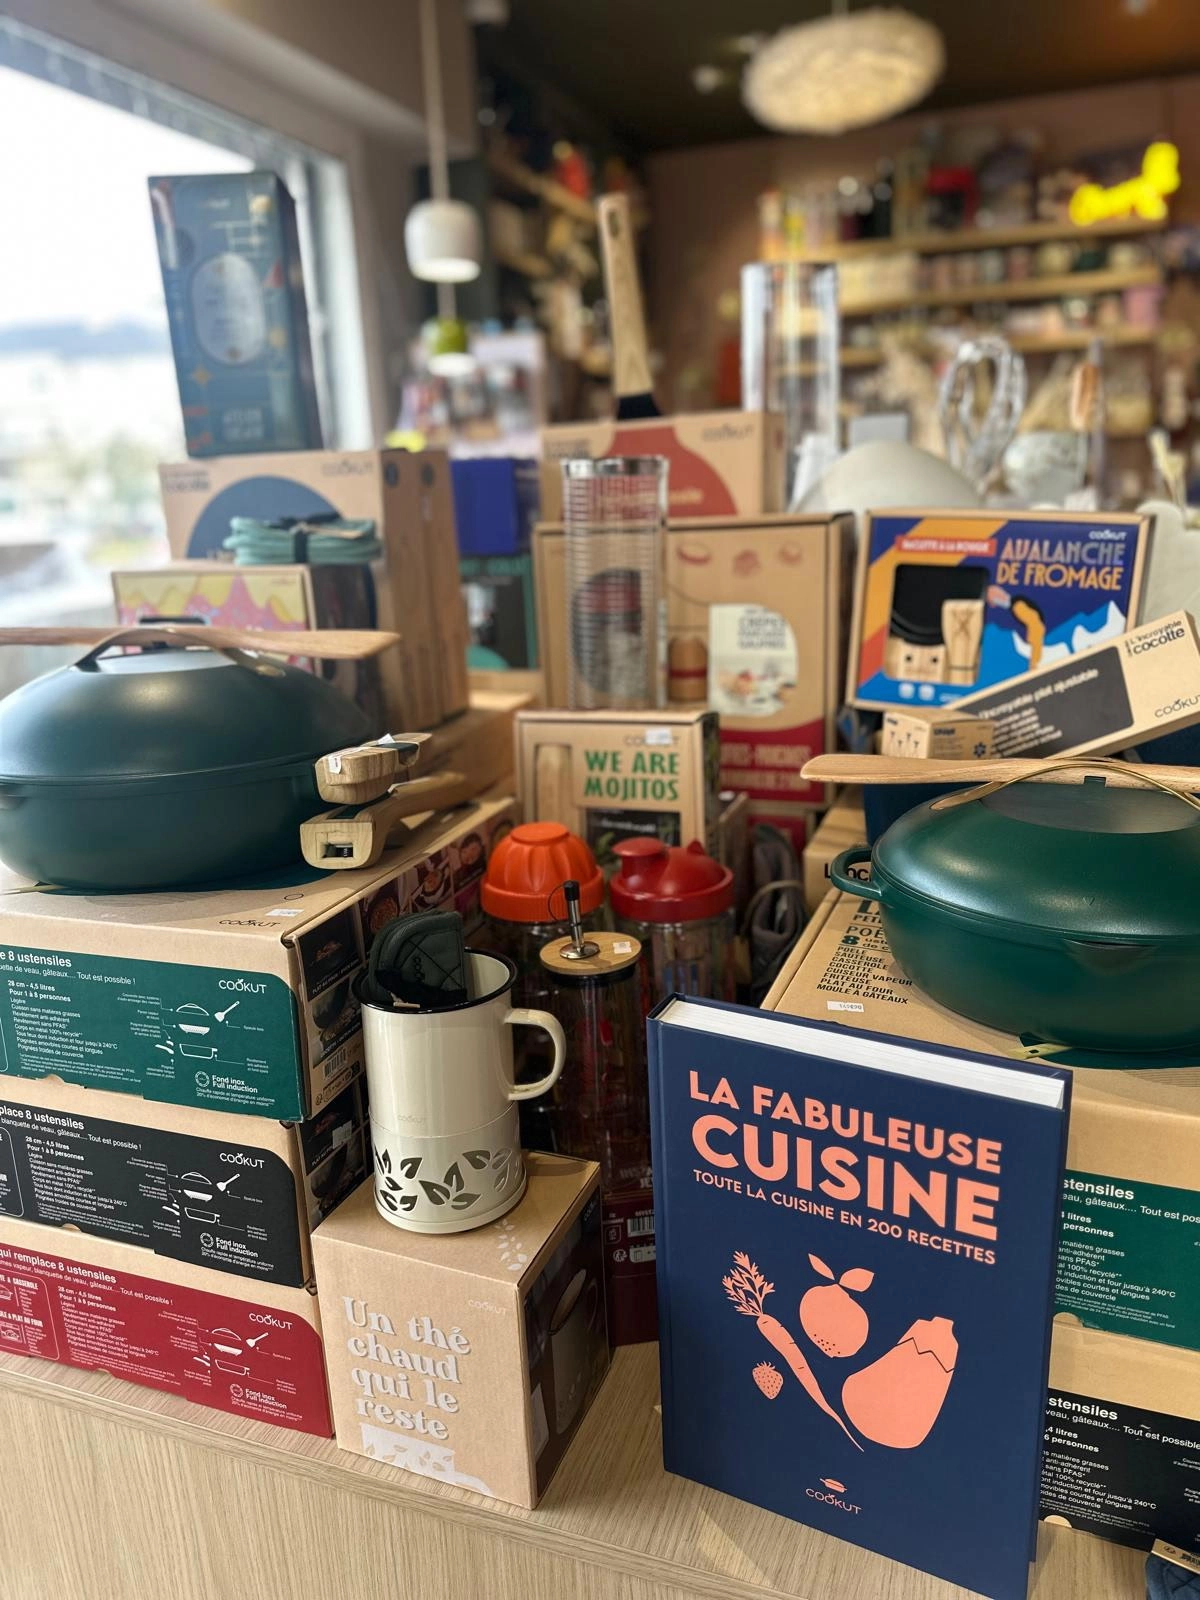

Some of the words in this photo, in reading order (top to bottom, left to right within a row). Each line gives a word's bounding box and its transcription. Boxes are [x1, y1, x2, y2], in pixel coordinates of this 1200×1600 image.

[1001, 537, 1126, 566] AVALANCHE
[996, 563, 1019, 584] DE
[1024, 565, 1124, 590] FROMAGE
[1133, 628, 1185, 654] cocotte
[584, 751, 621, 772] WE
[632, 752, 679, 775] ARE
[584, 778, 679, 801] MOJITOS
[845, 925, 885, 939] POÊ
[842, 936, 861, 946] 8
[8, 951, 15, 961] 8
[17, 953, 72, 968] ustensiles
[832, 957, 889, 970] CASSEROLE
[835, 951, 885, 964] SAUTEUSE
[14, 965, 23, 973] de
[77, 971, 91, 980] Tout
[92, 974, 103, 982] est
[104, 975, 132, 985] possible
[829, 962, 873, 973] COCOTTE
[823, 972, 872, 985] FRITEUSE
[826, 967, 870, 978] CUISEUR
[872, 975, 913, 986] VAPEUR
[39, 983, 56, 991] litres
[219, 978, 267, 994] COOKUT
[816, 984, 851, 994] MOULE
[820, 978, 847, 987] PLAT
[866, 985, 894, 995] FOUR
[9, 988, 23, 996] Pour
[39, 993, 71, 1002] personnes
[212, 1075, 230, 1084] Fond
[230, 1077, 245, 1086] inox
[212, 1081, 226, 1089] Full
[226, 1082, 258, 1094] induction
[0, 1105, 24, 1118] place
[25, 1110, 32, 1120] 8
[34, 1113, 85, 1130] ustensiles
[689, 1070, 740, 1110] LA
[752, 1085, 1002, 1175] FABULEUSE
[55, 1142, 70, 1150] litres
[88, 1133, 101, 1143] Tout
[102, 1137, 112, 1145] est
[112, 1140, 138, 1150] possible
[27, 1144, 41, 1152] Pour
[55, 1149, 85, 1161] personnes
[219, 1152, 265, 1169] COOKUT
[691, 1114, 1000, 1241] CUISINE
[1063, 1179, 1135, 1200] stensiles
[1063, 1193, 1083, 1203] eau,
[1140, 1205, 1161, 1217] Tout
[1164, 1211, 1180, 1220] est
[693, 1169, 742, 1194] TOUTE
[746, 1184, 767, 1201] LA
[771, 1191, 834, 1220] CUISINE
[840, 1211, 862, 1228] EN
[867, 1218, 903, 1239] 200
[907, 1229, 996, 1265] RECETTES
[1067, 1212, 1092, 1223] litres
[1063, 1222, 1114, 1238] personnes
[215, 1237, 231, 1247] Fond
[232, 1240, 247, 1250] inox
[216, 1242, 227, 1251] Full
[228, 1245, 259, 1258] induction
[1062, 1240, 1094, 1251] matières
[1095, 1246, 1125, 1257] grasses
[13, 1252, 57, 1270] remplace
[58, 1261, 65, 1271] 8
[66, 1266, 117, 1284] ustensiles
[1067, 1263, 1088, 1273] 100%
[64, 1273, 72, 1282] de
[120, 1287, 133, 1297] Tout
[134, 1291, 144, 1299] est
[144, 1294, 169, 1305] possible
[1055, 1277, 1081, 1287] ovibles
[1082, 1282, 1110, 1293] courtes
[1111, 1287, 1119, 1295] et
[1120, 1289, 1150, 1301] longues
[1063, 1270, 1096, 1282] induction
[1098, 1276, 1106, 1284] et
[1107, 1279, 1122, 1287] four
[1152, 1288, 1176, 1298] 240°C
[1070, 1286, 1080, 1294] de
[1081, 1289, 1117, 1301] couvercle
[87, 1300, 116, 1312] personnes
[249, 1313, 293, 1331] COOKUT
[342, 1295, 396, 1336] Un
[407, 1315, 471, 1354] thé
[347, 1333, 462, 1384] chaud
[351, 1366, 411, 1400] qui
[424, 1379, 459, 1413] le
[259, 1397, 287, 1409] induction
[1048, 1396, 1118, 1421] stensiles
[356, 1398, 449, 1440] reste
[1055, 1428, 1078, 1439] litres
[1123, 1425, 1143, 1437] Tout
[1145, 1431, 1160, 1441] est
[1162, 1435, 1200, 1450] possible
[1044, 1433, 1050, 1441] 6
[1051, 1436, 1099, 1453] personnes
[1045, 1464, 1061, 1472] sans
[1051, 1452, 1081, 1463] matières
[1081, 1460, 1109, 1471] grasses
[1055, 1473, 1074, 1482] 100%
[805, 1489, 862, 1514] COOKUT
[1052, 1480, 1083, 1491] induction
[1092, 1488, 1107, 1497] four
[1134, 1499, 1157, 1510] 240°C
[1068, 1496, 1101, 1509] couvercle
[1069, 1490, 1095, 1501] courtes
[1105, 1499, 1133, 1510] longues
